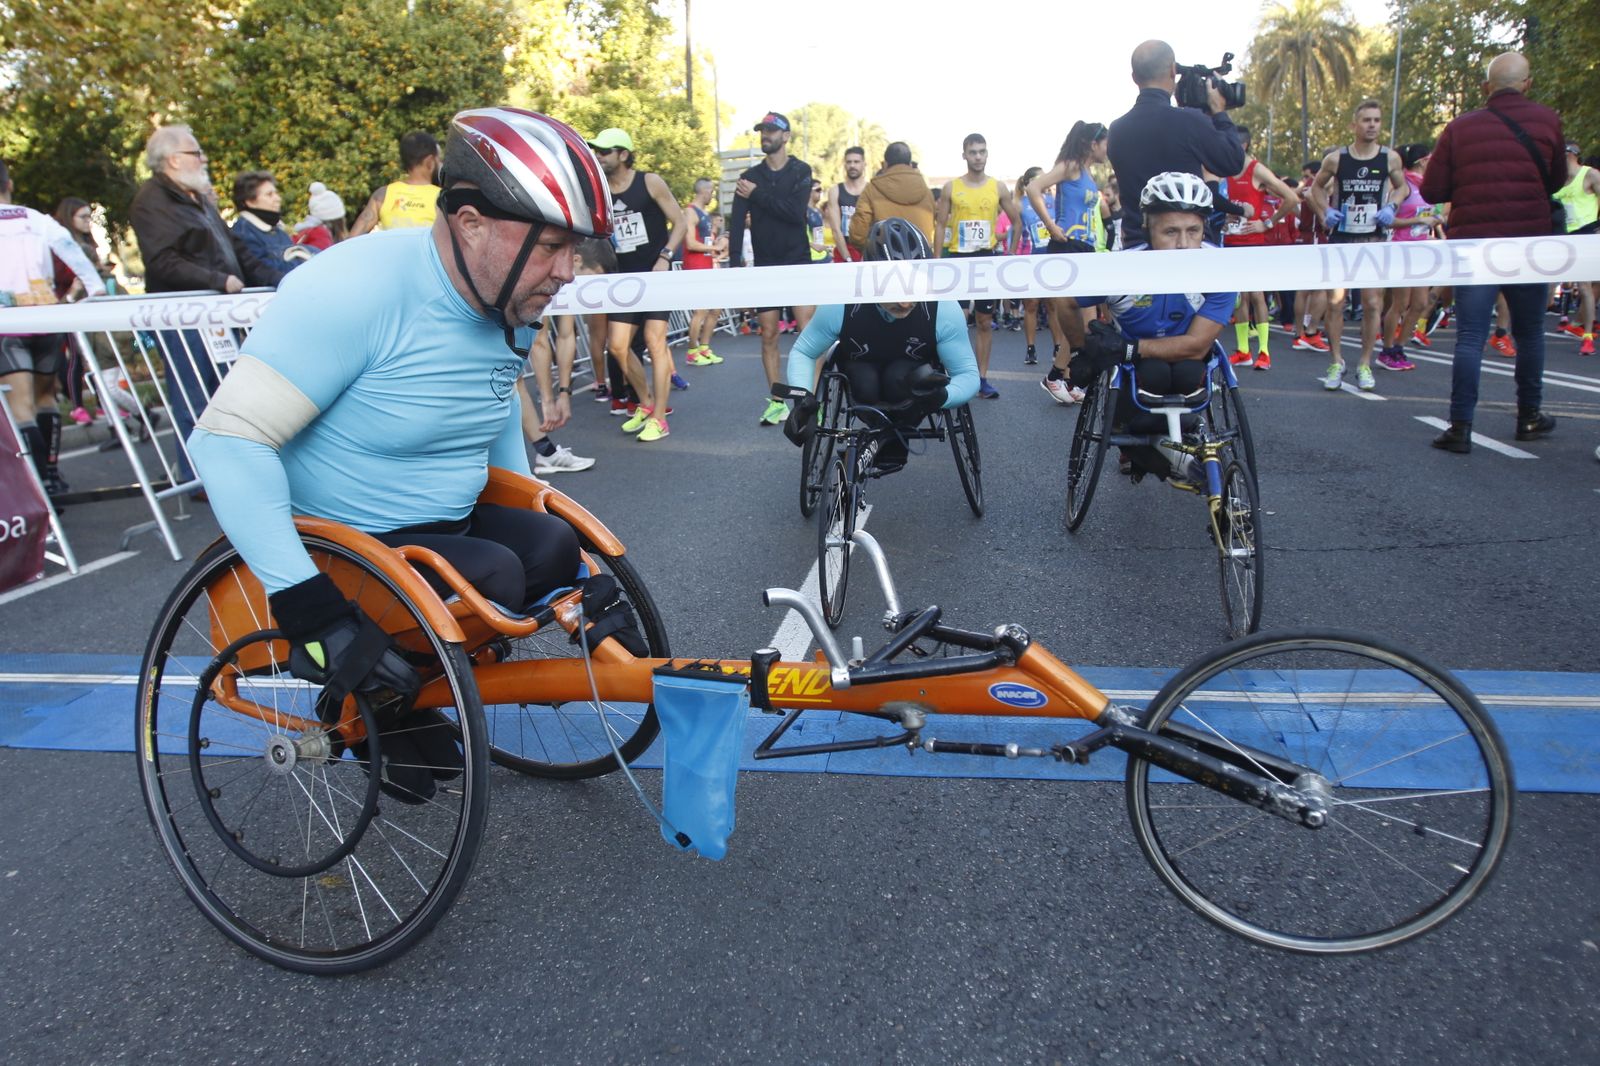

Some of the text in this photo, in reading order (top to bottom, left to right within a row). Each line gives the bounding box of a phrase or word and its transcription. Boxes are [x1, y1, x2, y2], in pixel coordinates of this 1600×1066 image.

[1353, 213, 1367, 224] 41
[618, 222, 638, 238] 147
[971, 228, 984, 239] 78
[767, 668, 831, 695] END
